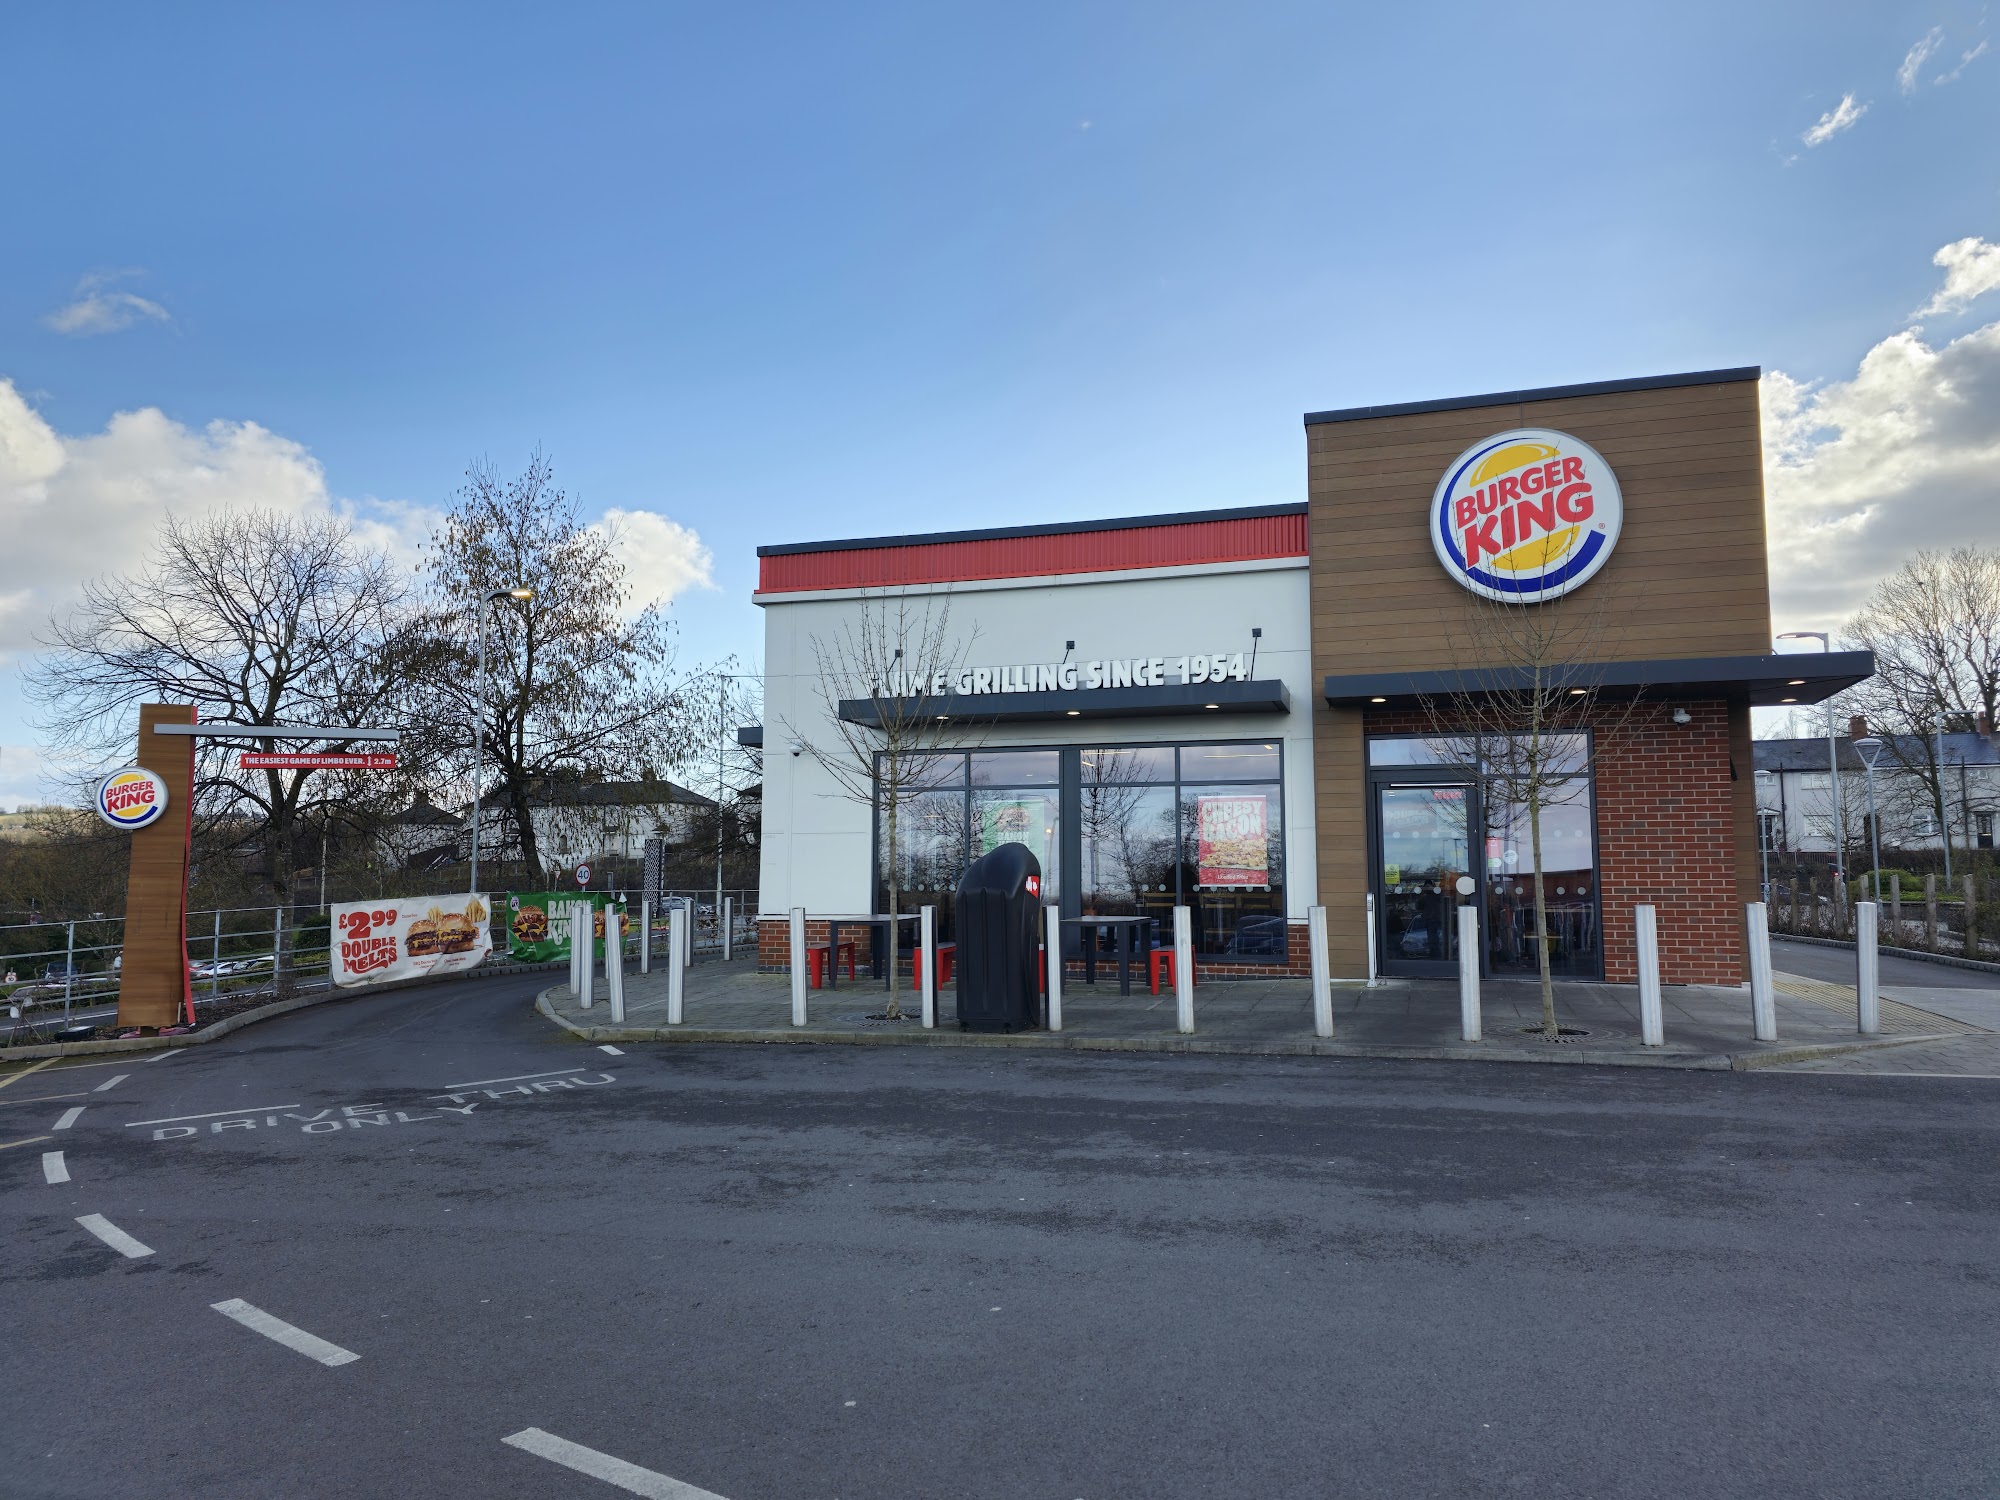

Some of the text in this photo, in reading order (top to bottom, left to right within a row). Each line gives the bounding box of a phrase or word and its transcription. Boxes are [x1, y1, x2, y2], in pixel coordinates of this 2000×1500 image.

[1455, 456, 1585, 529] BURGER
[1464, 482, 1594, 569] KING
[955, 664, 1078, 696] GRILLING
[1085, 657, 1165, 690] SINCE
[1176, 652, 1250, 686] 1954
[244, 757, 260, 765] THE
[260, 757, 289, 765] EASIEST
[289, 757, 311, 765] GAME
[311, 757, 321, 765] OF
[321, 757, 344, 765] LIMBO
[345, 757, 365, 765] EVER.
[105, 780, 154, 800] BURGER
[106, 789, 155, 814] KING
[1201, 801, 1263, 823] CHEESY
[1202, 813, 1262, 843] BACON
[577, 869, 589, 880] 40
[338, 909, 398, 939] £299
[340, 936, 397, 958] DOUBLE
[342, 947, 398, 974] MELTS
[152, 1073, 617, 1141] DRIVE THRU
[300, 1103, 480, 1135] ONLY
